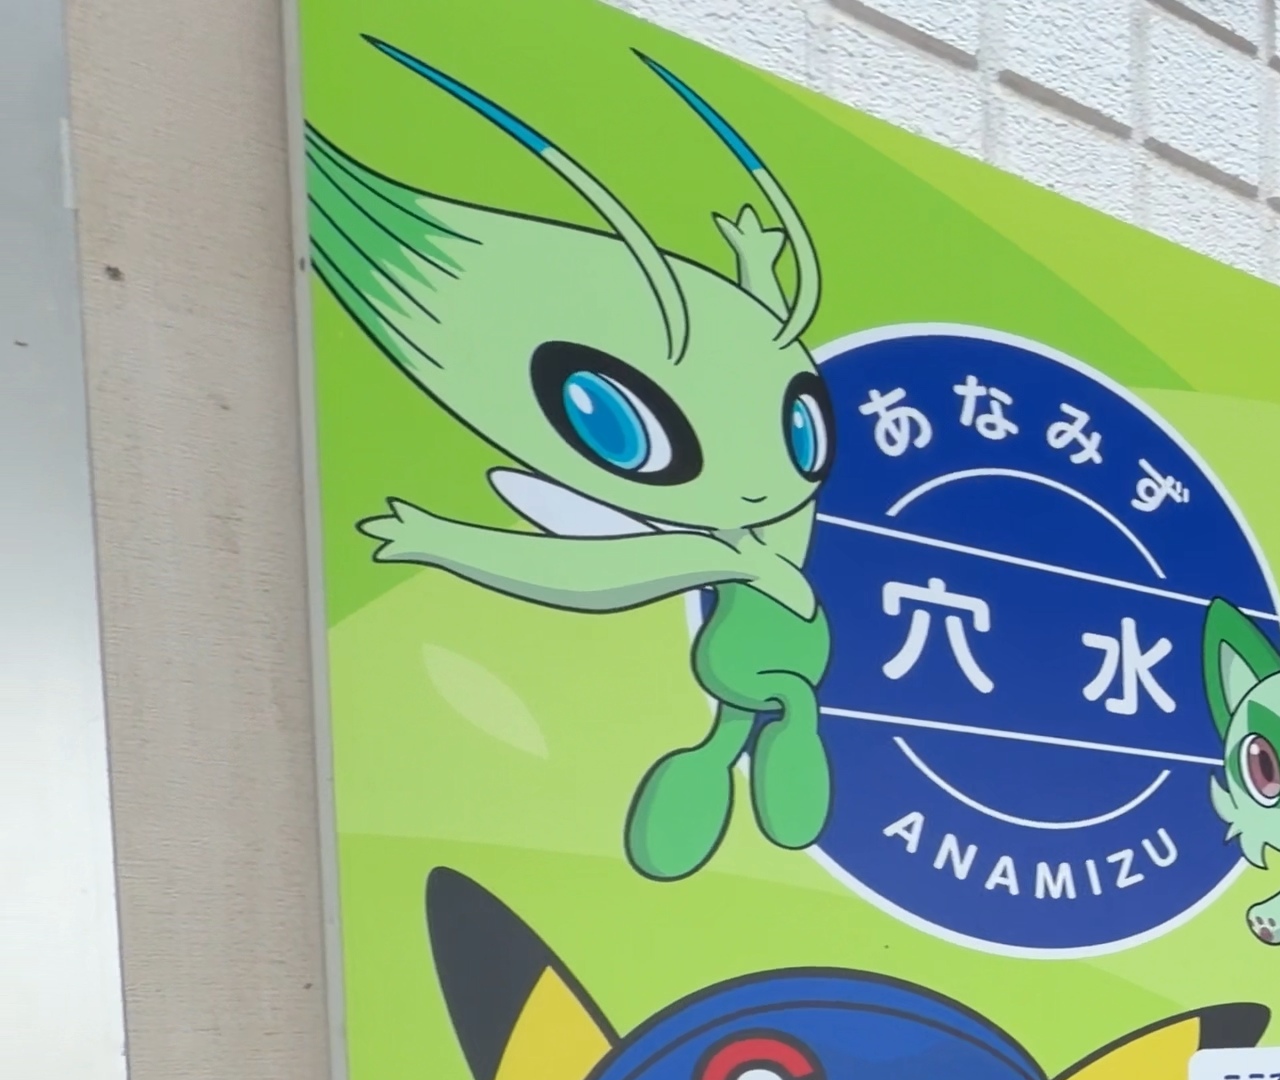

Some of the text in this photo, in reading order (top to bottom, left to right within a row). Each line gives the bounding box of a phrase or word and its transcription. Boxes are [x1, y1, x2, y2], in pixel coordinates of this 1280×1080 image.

[859, 375, 1190, 512] あなみず
[881, 577, 1175, 714] 穴水
[883, 811, 1178, 900] ANAMIZU
